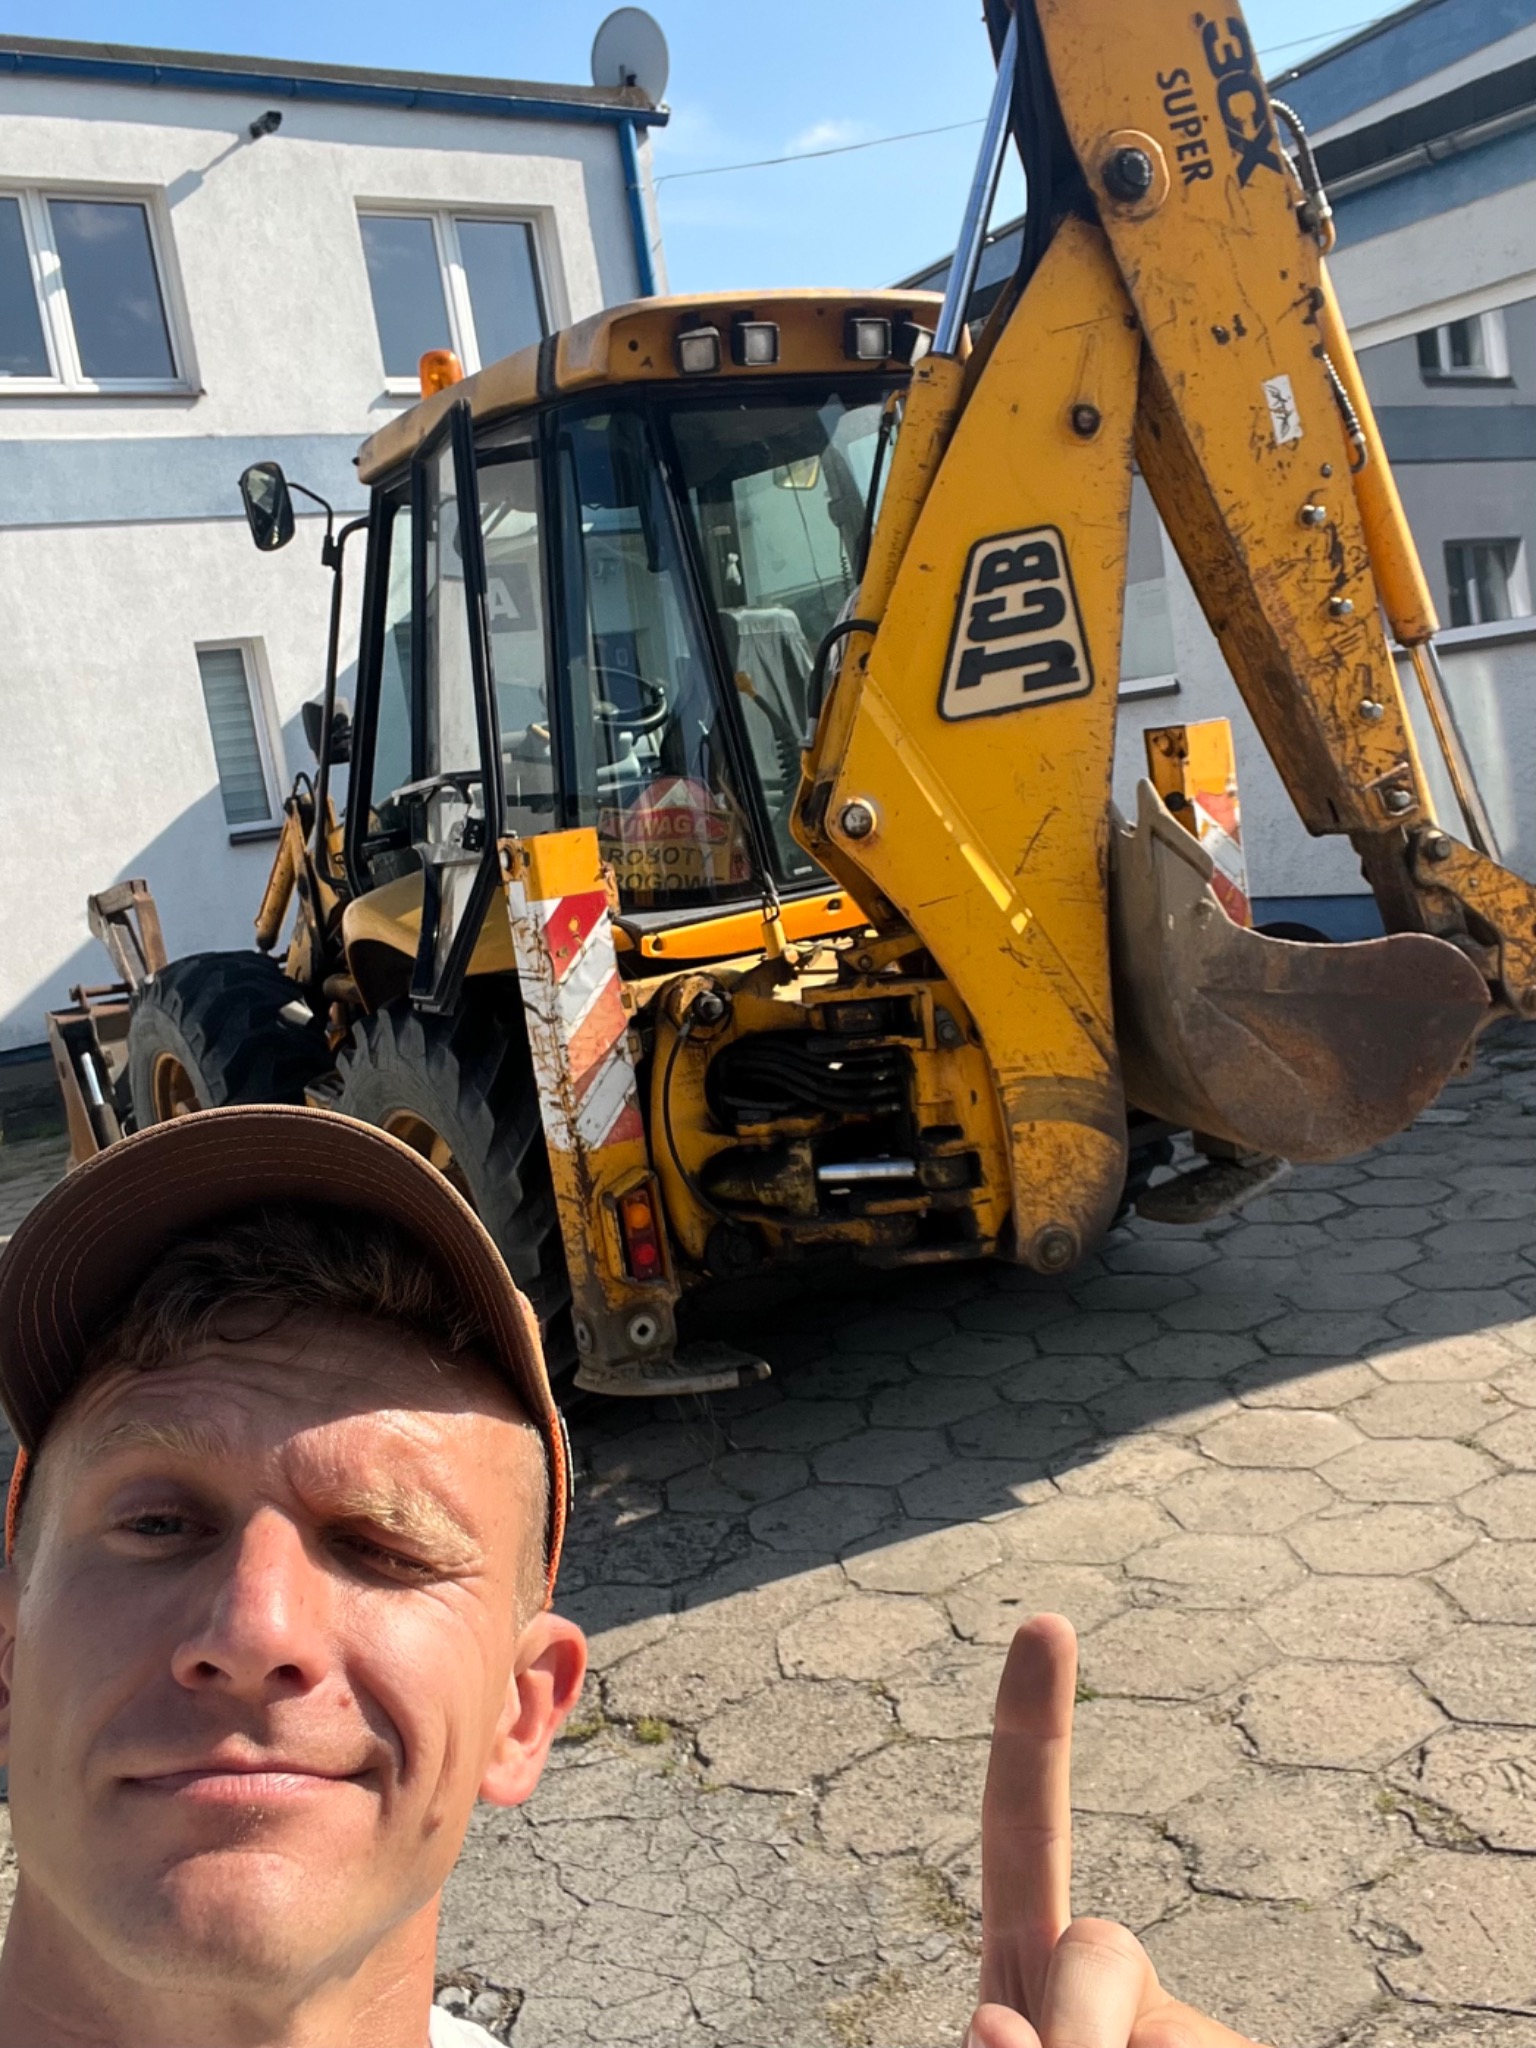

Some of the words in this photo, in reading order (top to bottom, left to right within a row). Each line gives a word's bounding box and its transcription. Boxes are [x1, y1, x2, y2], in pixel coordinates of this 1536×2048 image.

[1156, 67, 1214, 186] SUPER
[1202, 16, 1283, 188] 3CX
[955, 540, 1081, 693] JCB
[607, 846, 715, 867] ROBOTY
